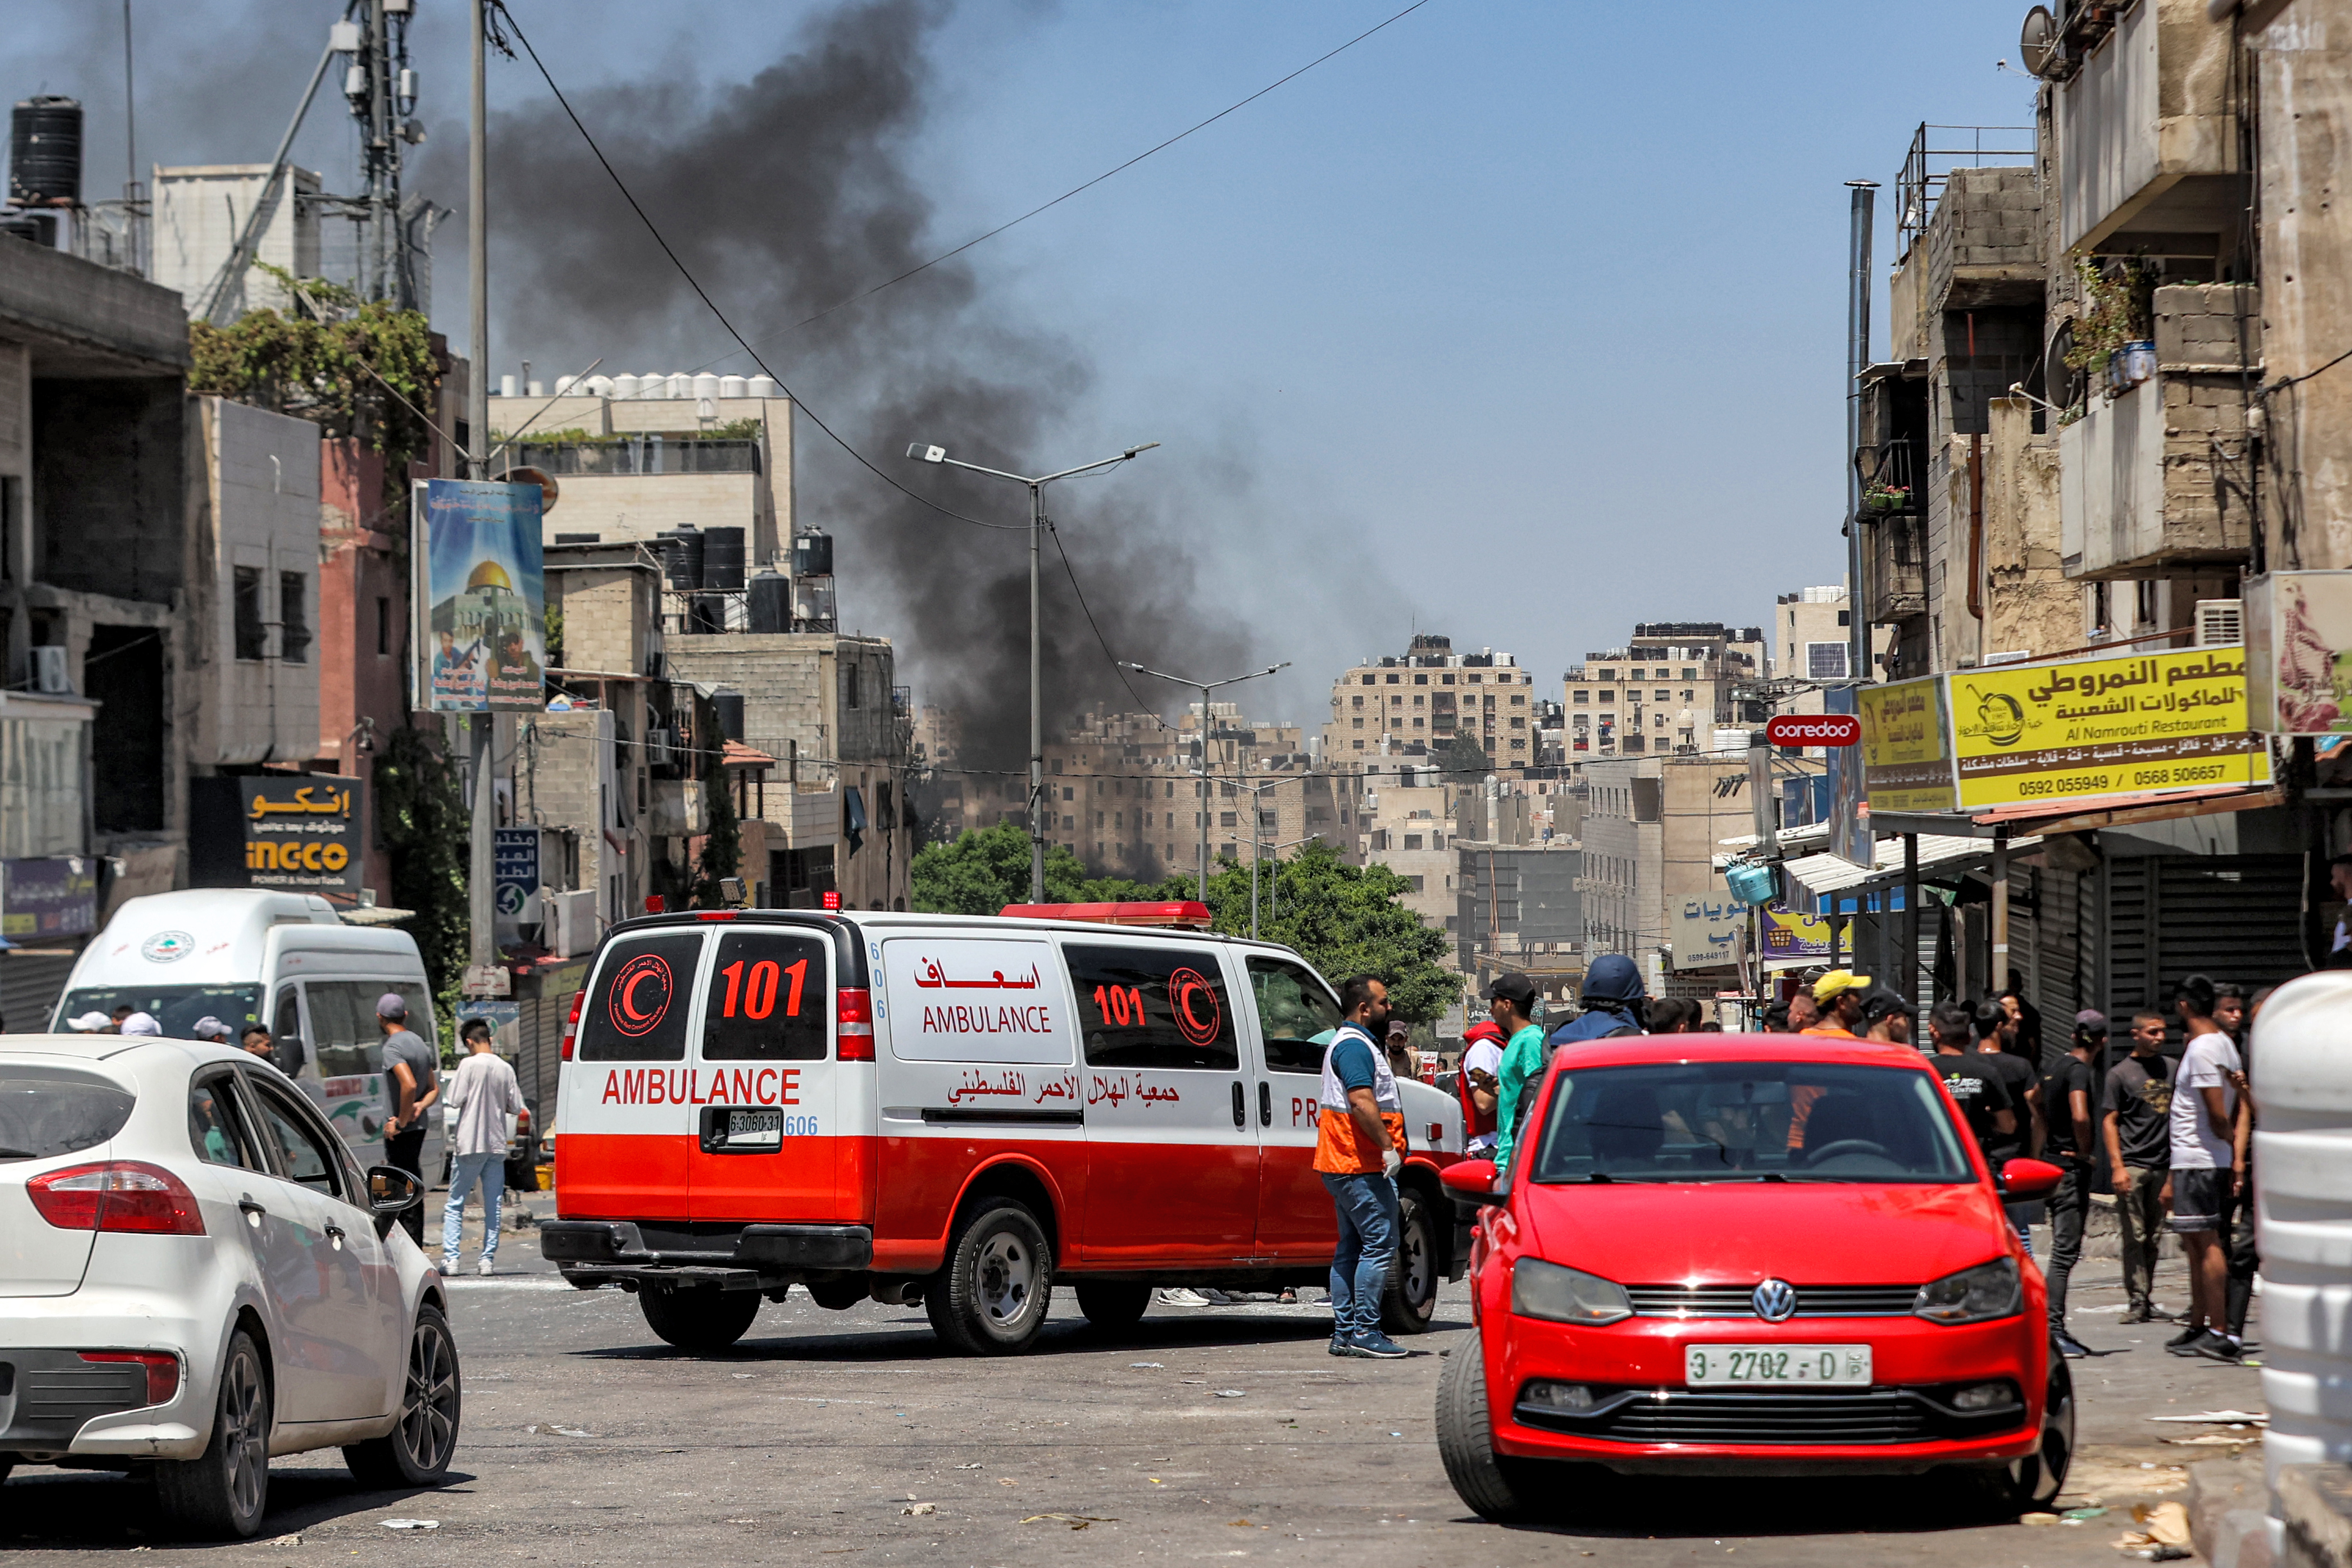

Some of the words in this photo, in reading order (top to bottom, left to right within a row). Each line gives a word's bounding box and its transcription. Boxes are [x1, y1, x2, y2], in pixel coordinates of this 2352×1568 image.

[2028, 659, 2158, 708] النمروطي
[2167, 654, 2245, 687] مطعم
[2056, 696, 2135, 722] الشعبية
[1774, 721, 1853, 737] ooredoo
[2065, 727, 2079, 741] Al
[2083, 720, 2148, 740] Namrouti
[2152, 716, 2227, 734] Restaurant
[2019, 779, 2053, 796] 0592
[2056, 775, 2109, 793] 055949
[2134, 769, 2169, 786] 0568
[2172, 764, 2226, 782] 506657
[247, 785, 351, 819] إنكو
[495, 833, 536, 848] مختب
[1684, 901, 1748, 922] لويات
[914, 956, 1041, 989] اسعاف
[1687, 951, 1730, 962] 0599-649117
[722, 958, 808, 1020] 101
[1094, 984, 1146, 1026] 101
[923, 1005, 1052, 1033] AMBULANCE
[602, 1068, 801, 1105] AMBULANCE
[947, 1068, 1026, 1107] الفلسطيني
[1033, 1068, 1080, 1104] الأحمر
[1088, 1074, 1129, 1108] الهلال
[1136, 1073, 1180, 1108] جمعية
[785, 1116, 818, 1136] 606
[1292, 1097, 1319, 1127] PR
